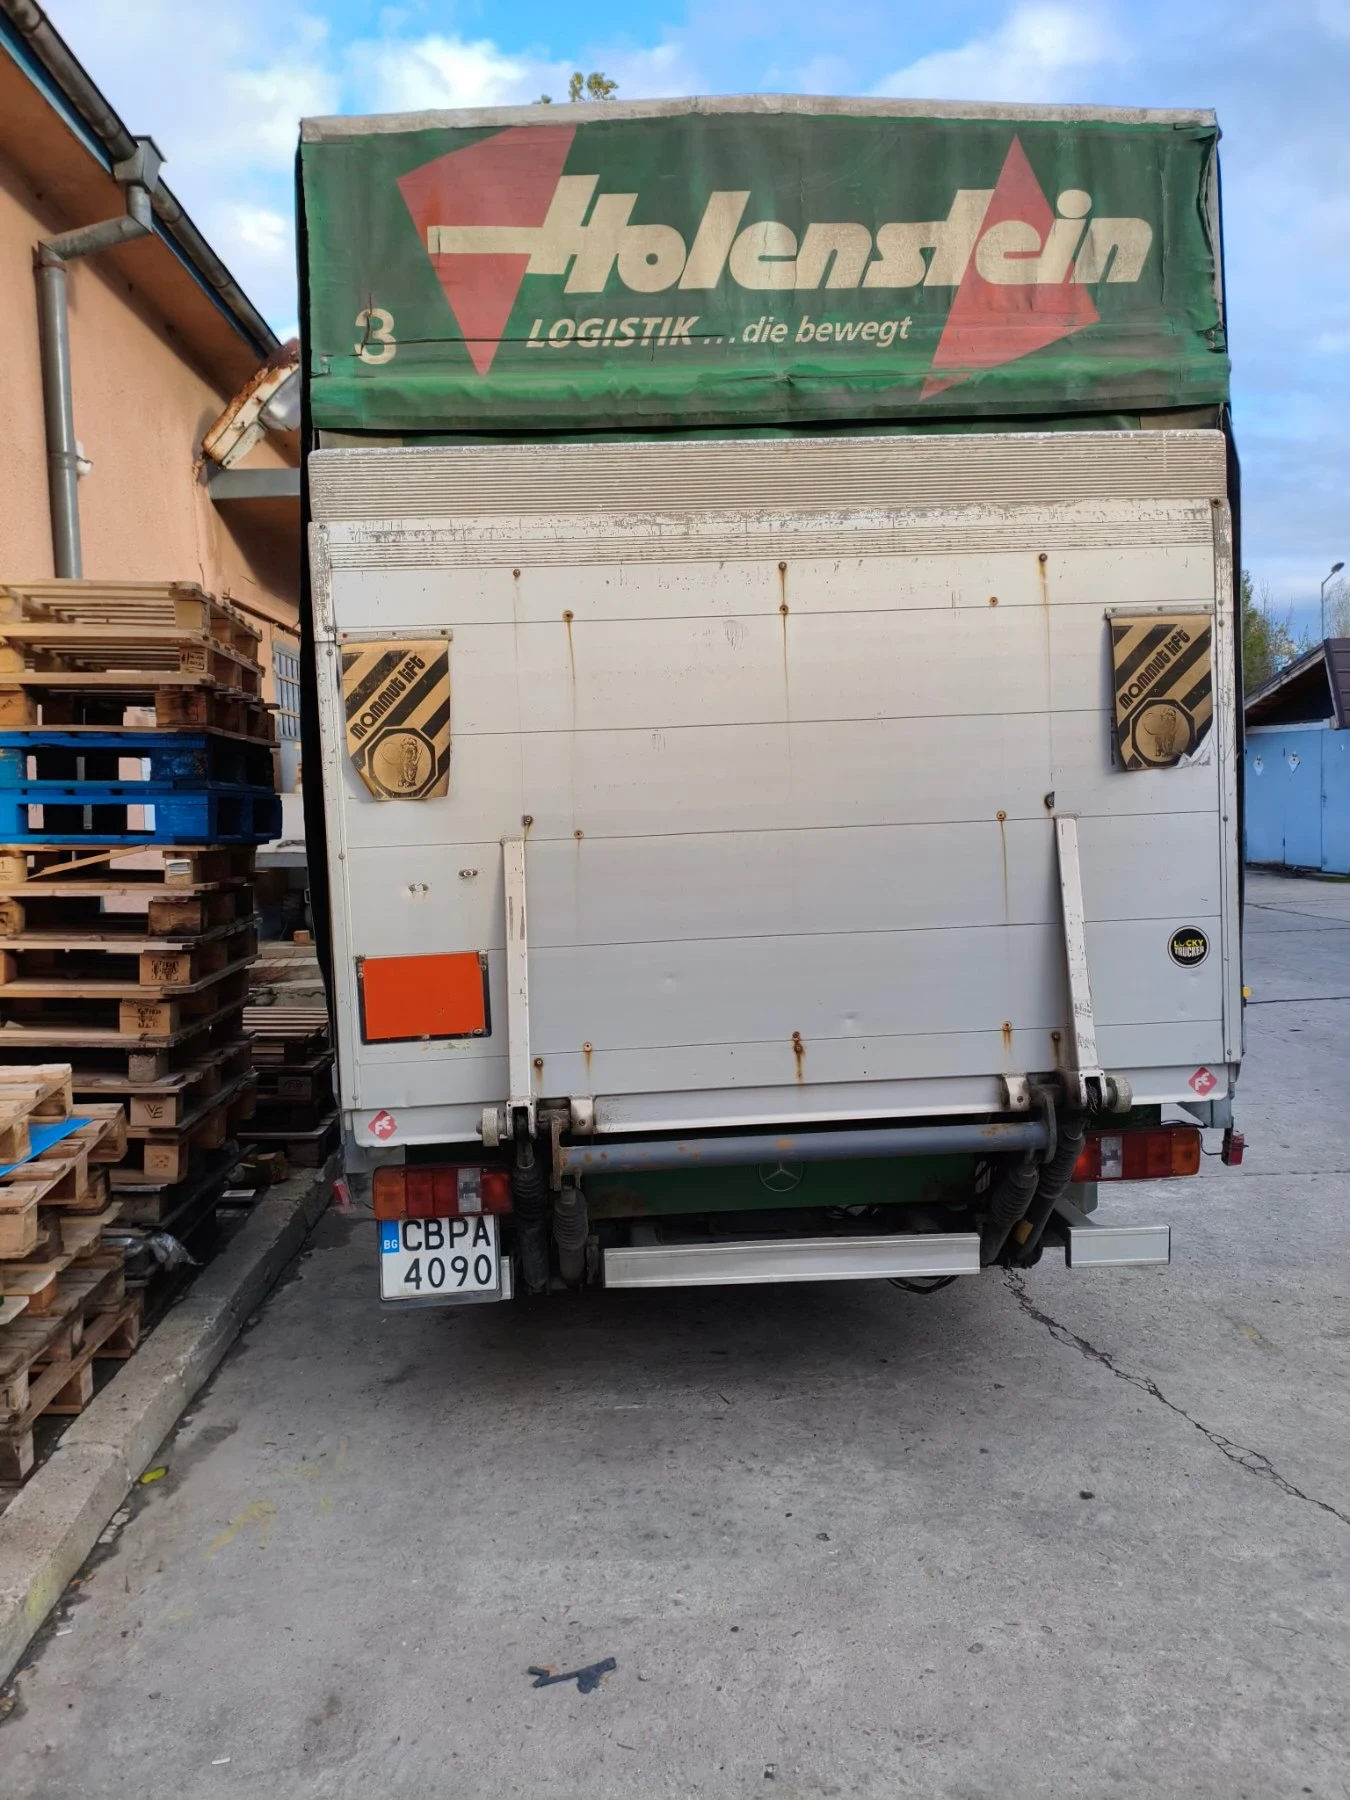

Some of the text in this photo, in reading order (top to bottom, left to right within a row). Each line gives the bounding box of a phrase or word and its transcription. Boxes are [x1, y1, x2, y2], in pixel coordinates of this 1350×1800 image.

[427, 174, 1152, 294] Holenstein
[354, 308, 396, 365] 3
[526, 316, 700, 348] LOGISTIK
[795, 314, 912, 348] bewegt
[1119, 628, 1191, 711] mammut lift
[350, 655, 426, 741] mammut lift
[383, 1239, 398, 1250] BG
[402, 1215, 492, 1252] CBPA
[404, 1254, 492, 1290] 4090
